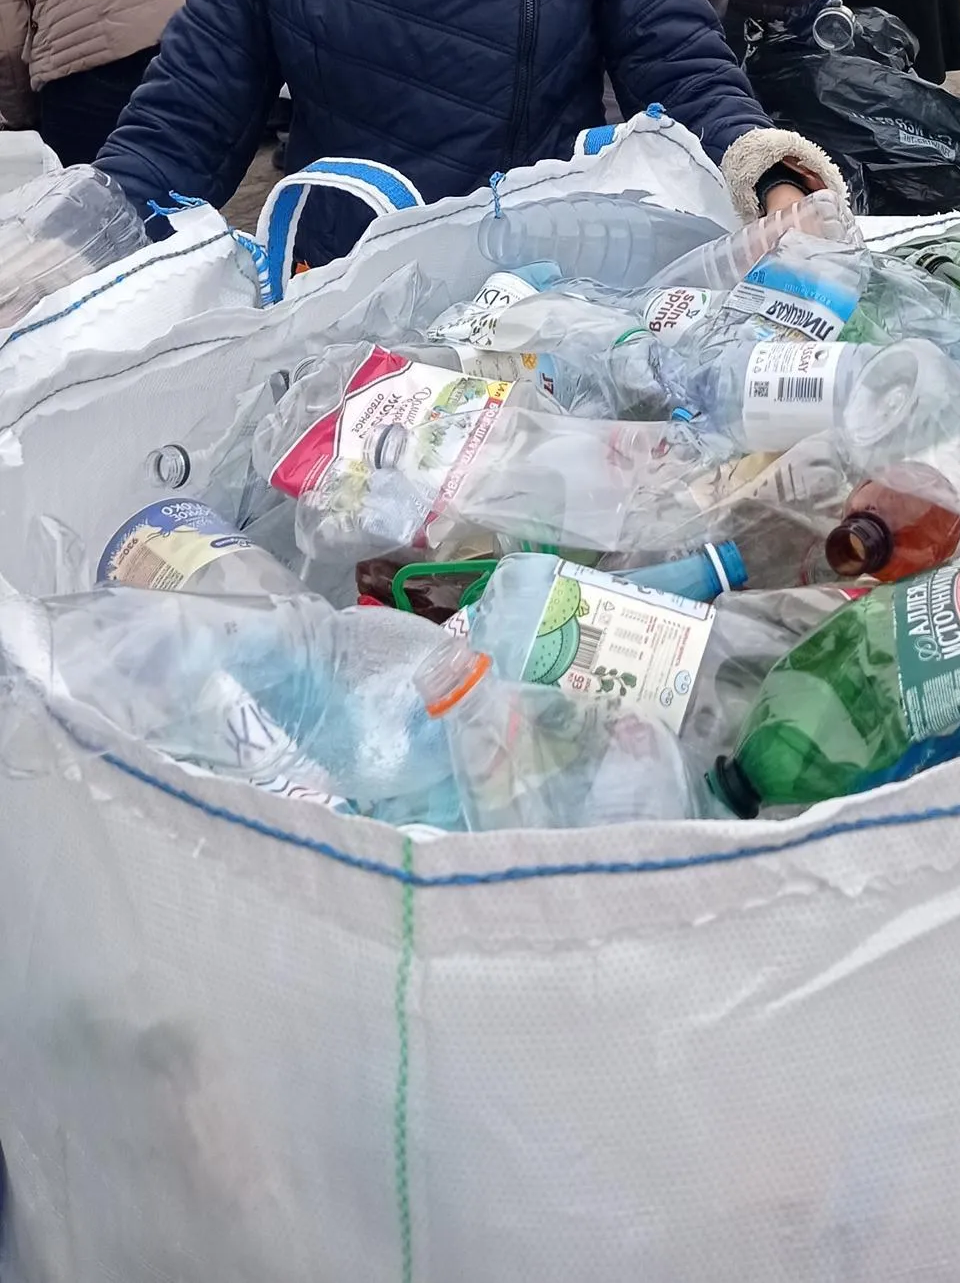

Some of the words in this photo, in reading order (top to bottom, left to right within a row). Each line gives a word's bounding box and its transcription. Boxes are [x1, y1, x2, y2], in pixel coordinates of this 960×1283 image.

[663, 294, 694, 329] saint
[765, 300, 834, 341] ЛИПЕЦКАЯ
[906, 583, 931, 636] АЛЛЕЯ
